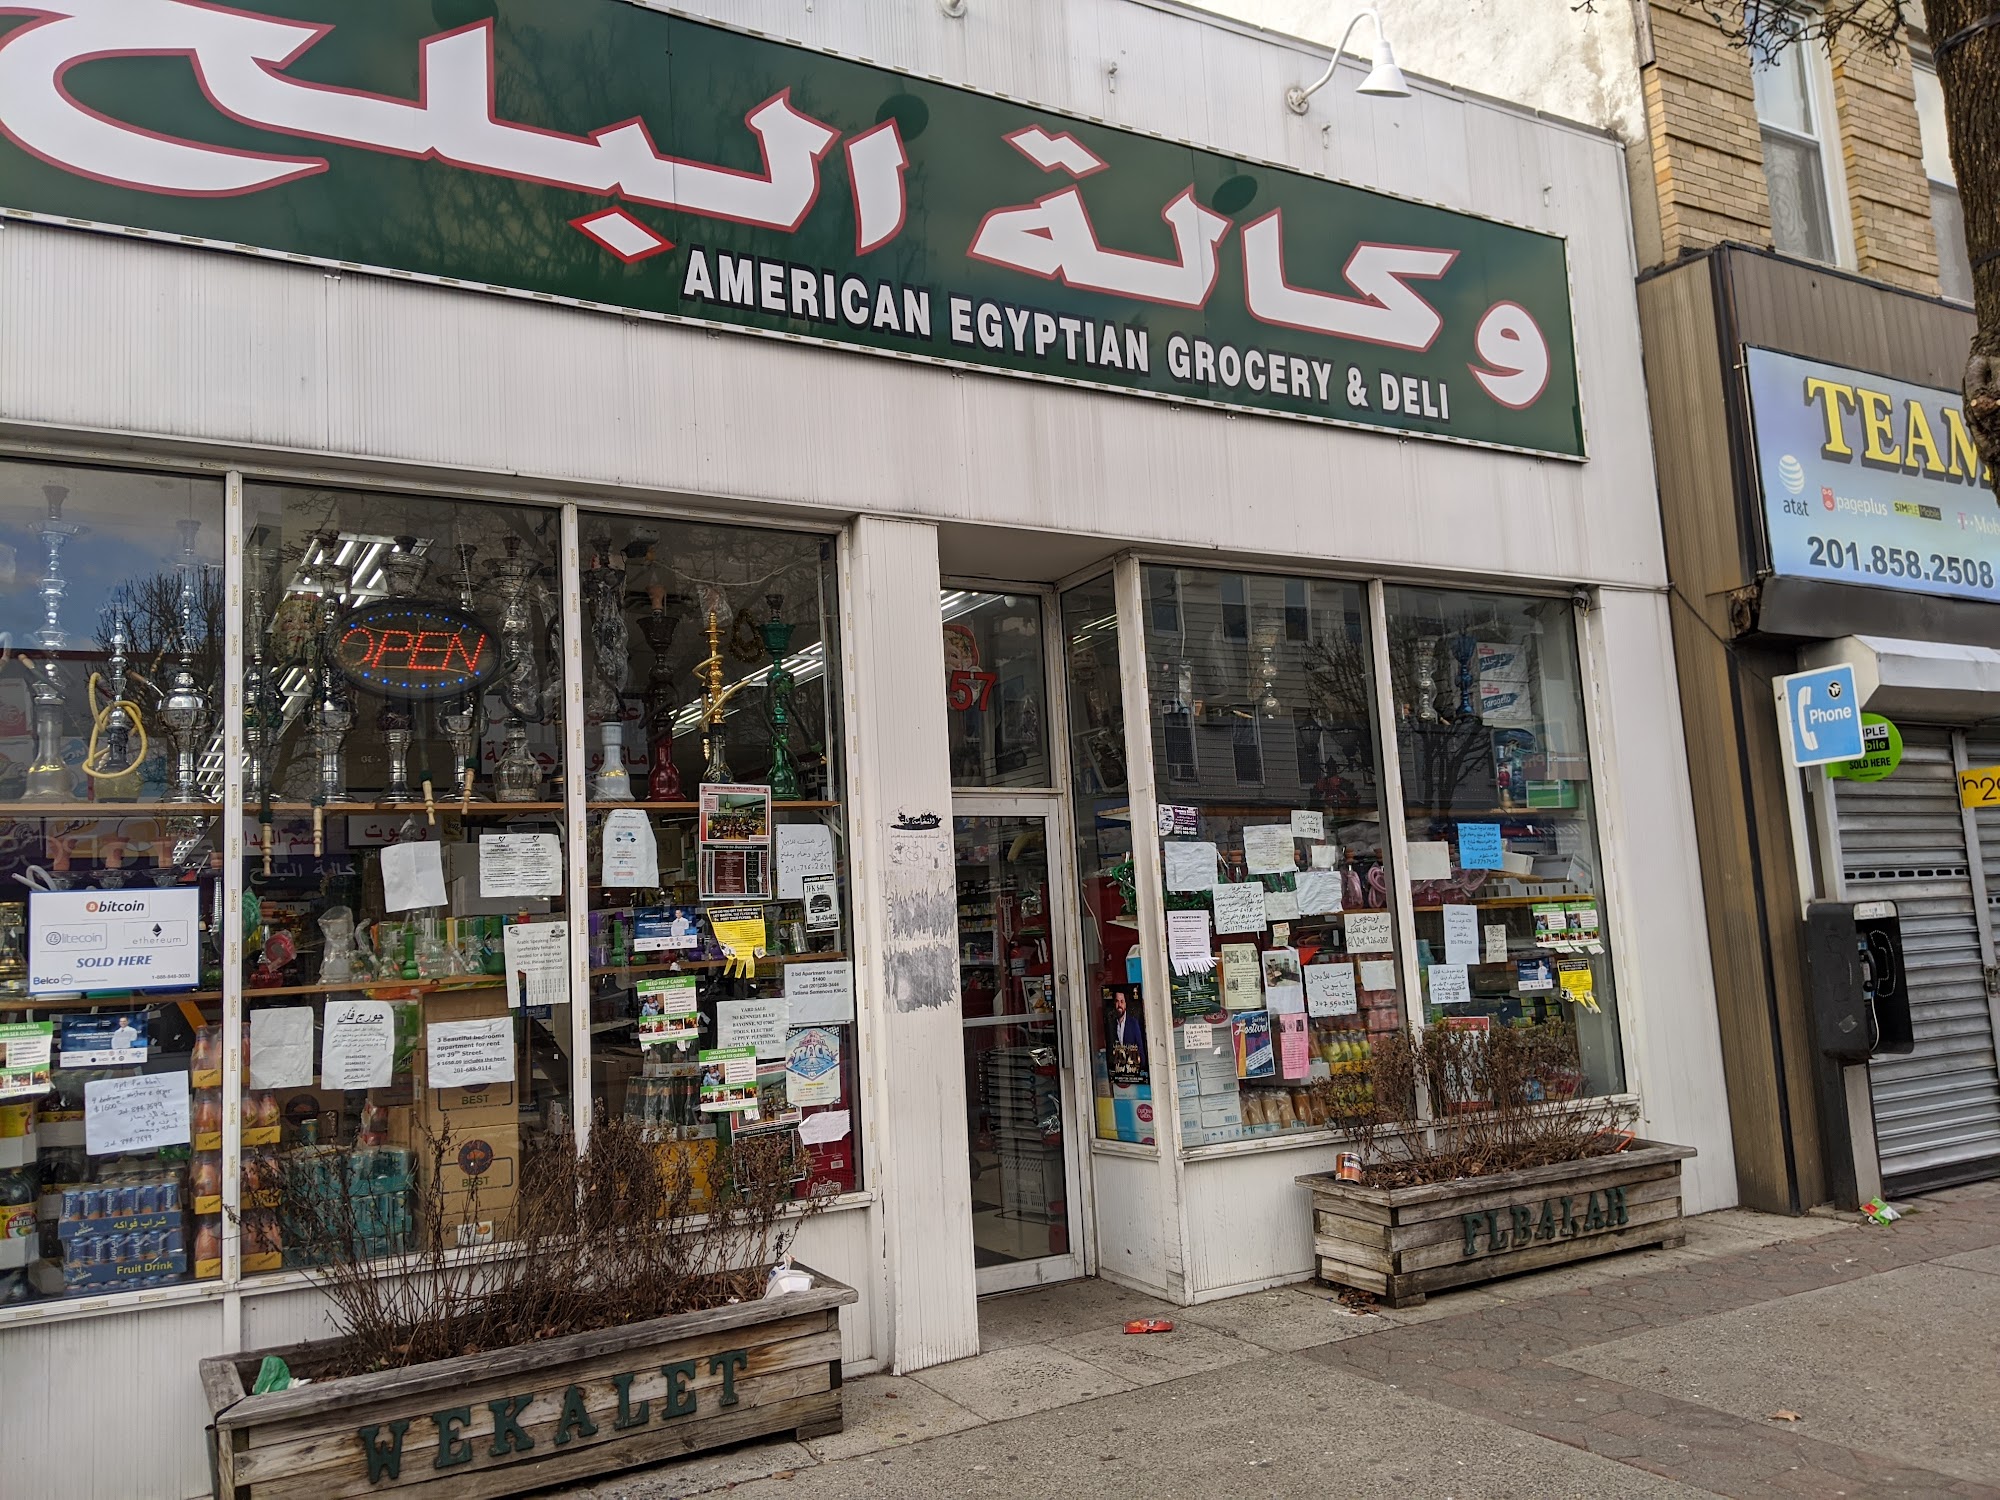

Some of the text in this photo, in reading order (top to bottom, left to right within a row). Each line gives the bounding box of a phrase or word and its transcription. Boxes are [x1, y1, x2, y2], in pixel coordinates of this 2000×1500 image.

[683, 249, 1450, 420] AMERICAN EGYPTIAN GROCERY & DELI
[1783, 498, 1809, 517] at&t
[1836, 496, 1888, 517] pageplus
[1894, 501, 1942, 520] SIMPLE Mobile
[1807, 536, 1995, 589] 201.858.2508
[340, 628, 487, 672] OPEN
[1809, 705, 1852, 725] Phone
[1850, 757, 1891, 770] SOLD HERE
[98, 900, 145, 913] bitcoin
[62, 933, 103, 944] litecoin
[132, 937, 182, 945] ethereum
[76, 955, 153, 968] SOLD HERE
[33, 976, 60, 985] Belco
[443, 1035, 472, 1043] Beautiful
[462, 1094, 489, 1105] BEST
[462, 1176, 490, 1187] BEST
[141, 1217, 167, 1229] شراب
[117, 1261, 173, 1275] Fruit Drink
[359, 1349, 748, 1485] WEKALET
